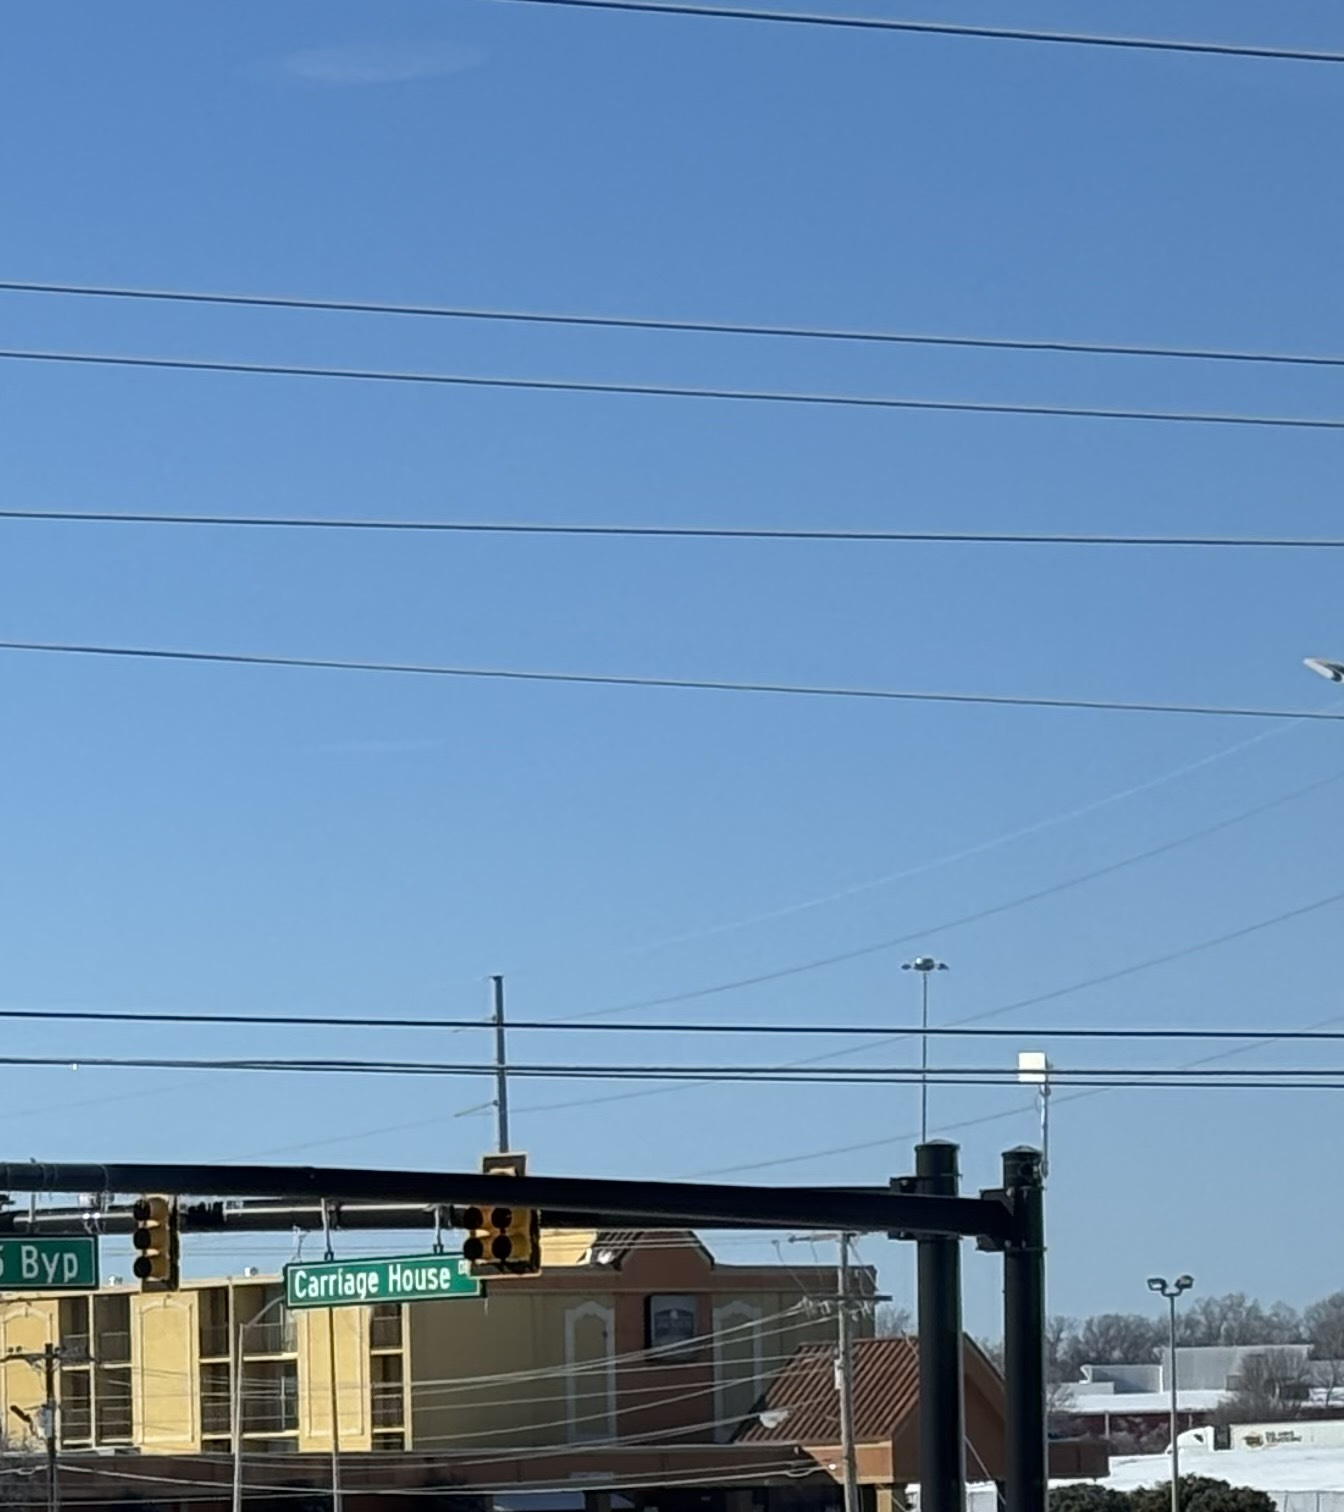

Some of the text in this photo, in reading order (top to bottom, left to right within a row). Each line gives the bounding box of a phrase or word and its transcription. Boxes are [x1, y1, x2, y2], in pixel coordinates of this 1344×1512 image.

[20, 1244, 79, 1284] Byp
[294, 1267, 380, 1300] Carriage
[388, 1262, 452, 1293] House
